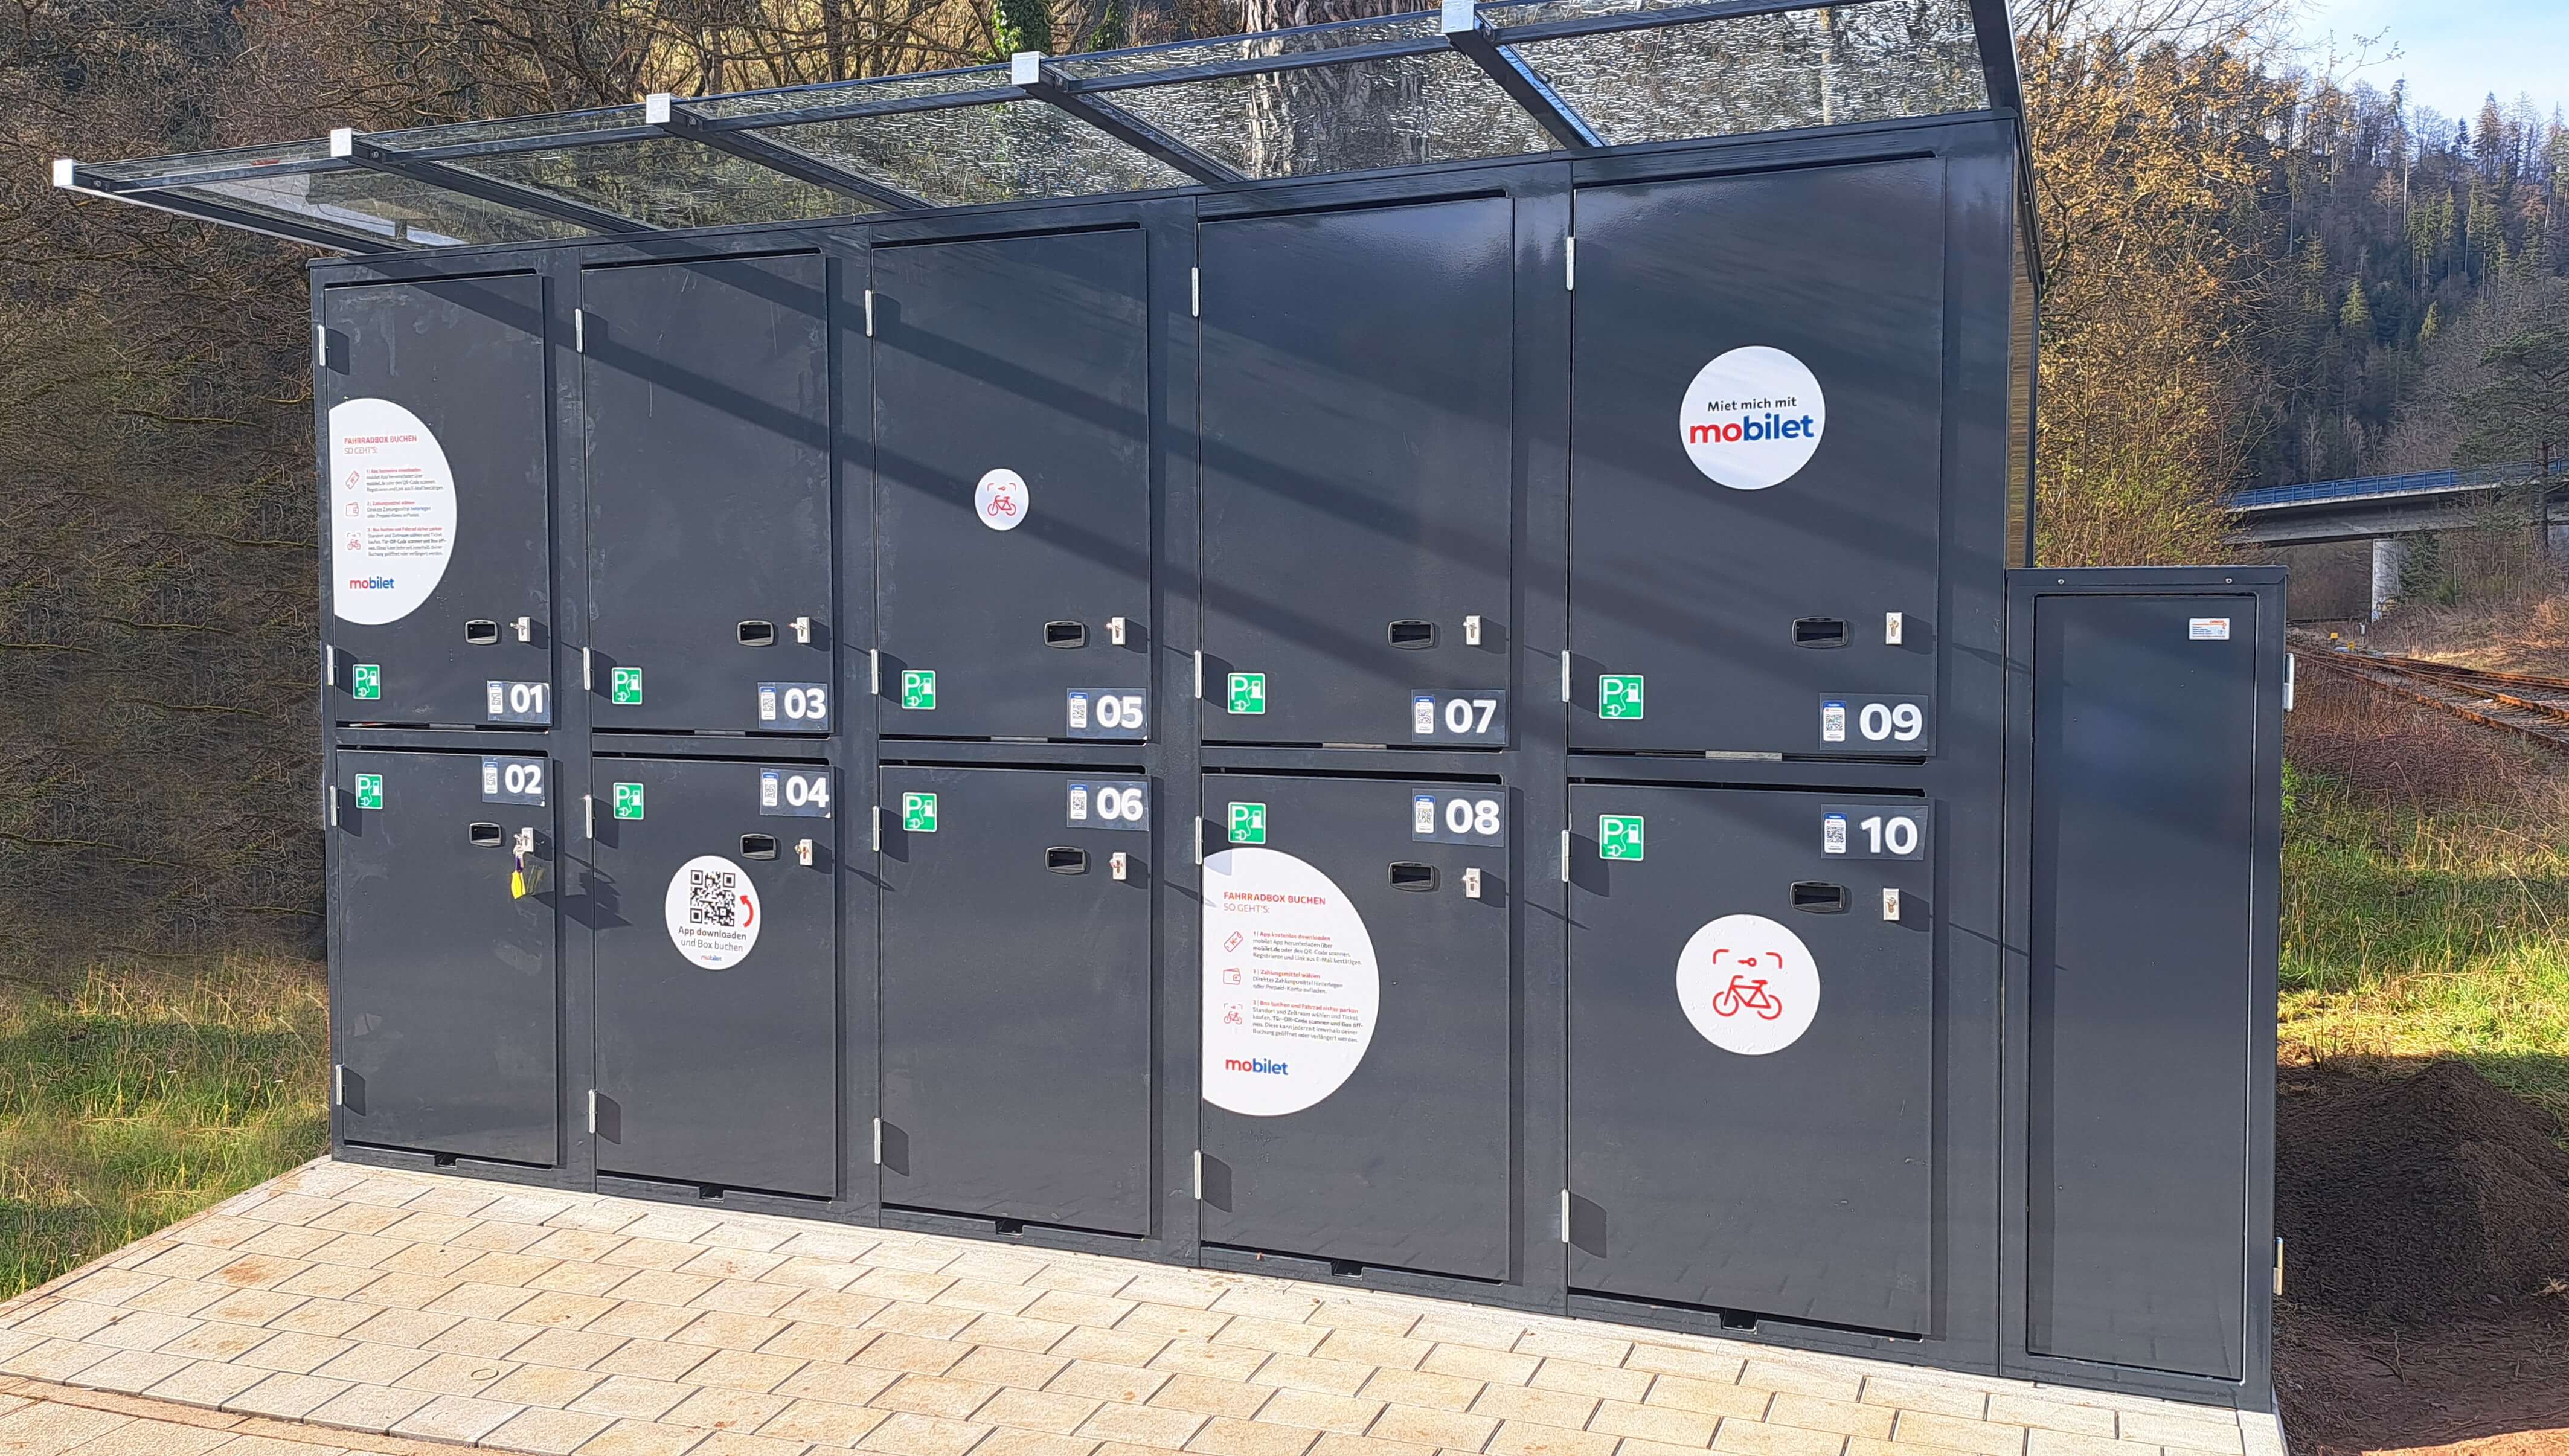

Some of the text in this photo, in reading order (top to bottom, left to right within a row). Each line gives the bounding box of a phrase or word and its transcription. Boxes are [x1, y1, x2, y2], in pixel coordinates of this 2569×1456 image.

[1708, 397, 1797, 411] Miet mich mit
[1690, 413, 1814, 443] mobilet
[350, 576, 395, 589] mobilet
[355, 667, 367, 688] P
[614, 670, 626, 692] P
[905, 673, 918, 696] P
[1231, 676, 1246, 700] P
[510, 684, 543, 713] 01
[1603, 678, 1623, 704] P
[784, 688, 826, 719] 03
[1097, 695, 1143, 728] 05
[1445, 699, 1496, 733] 07
[1859, 703, 1922, 741] 09
[358, 777, 369, 797] P
[505, 764, 541, 794] 02
[616, 786, 629, 807] P
[786, 775, 829, 807] 04
[906, 795, 922, 818] P
[1097, 787, 1143, 821] 06
[1232, 806, 1249, 829] P
[1446, 799, 1499, 835] 08
[1604, 819, 1623, 844] P
[1861, 816, 1918, 855] 10
[1224, 892, 1326, 905] FAHRRADBOX BUCHEN
[1224, 903, 1270, 914] SO GEHT'S:
[678, 926, 746, 940] App downloaden
[715, 941, 743, 952] buchen
[1225, 1057, 1289, 1076] mobilet
